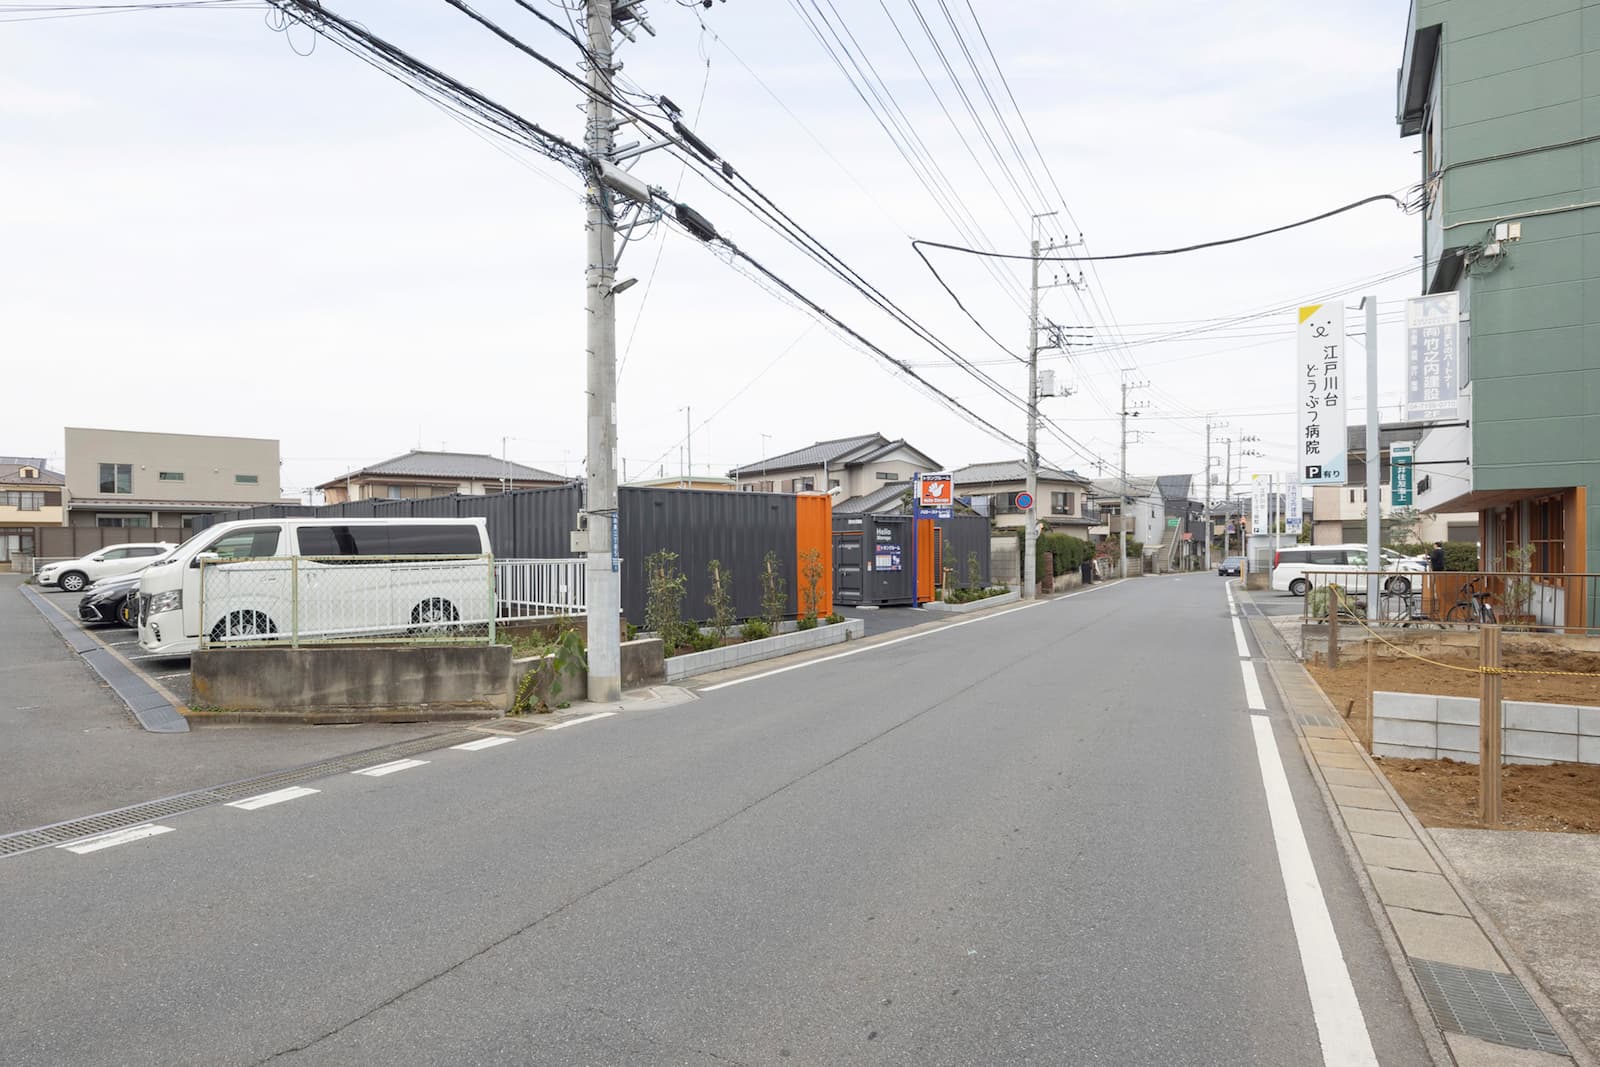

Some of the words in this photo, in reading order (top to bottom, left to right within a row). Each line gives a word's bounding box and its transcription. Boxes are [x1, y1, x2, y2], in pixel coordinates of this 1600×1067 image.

[1323, 345, 1338, 407] 江戸川台
[1305, 364, 1320, 455] どうぶつ病院
[1323, 470, 1340, 478] 有り
